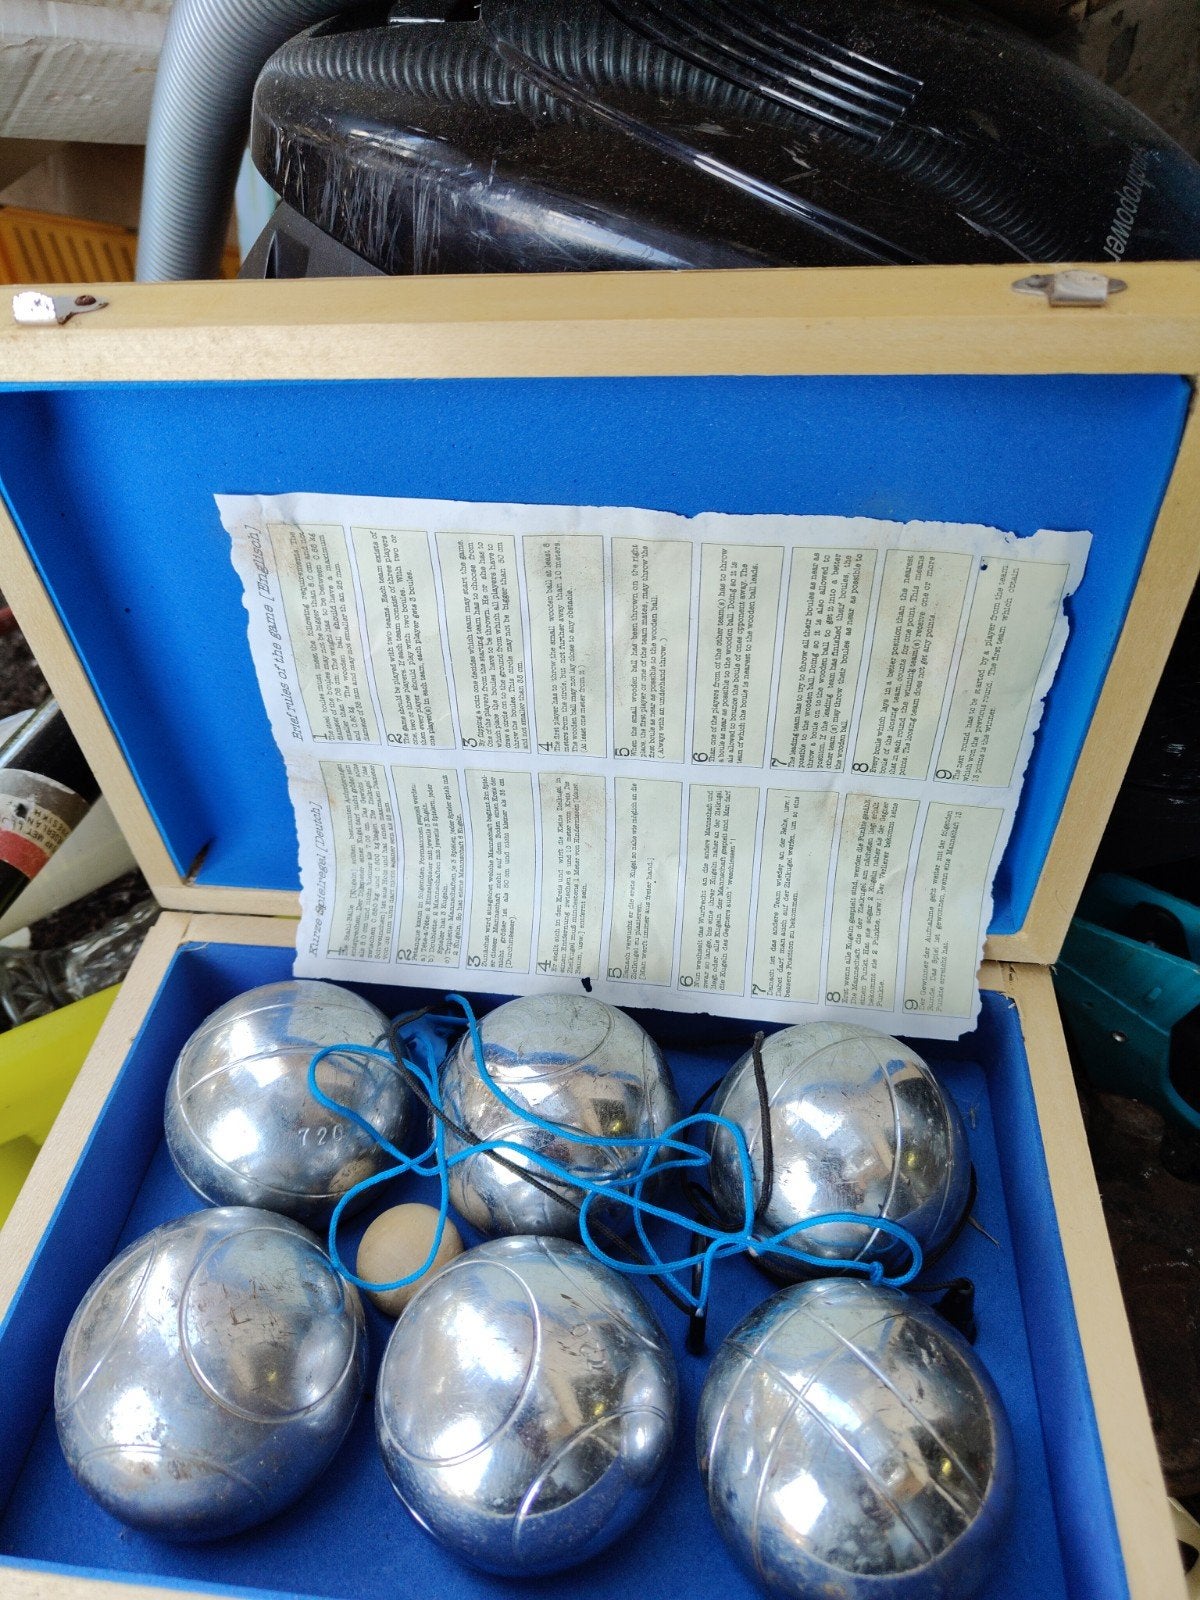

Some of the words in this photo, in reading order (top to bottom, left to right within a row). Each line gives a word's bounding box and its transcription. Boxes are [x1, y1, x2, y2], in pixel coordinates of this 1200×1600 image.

[244, 524, 274, 600] [Englisch]
[387, 733, 403, 742] 2
[462, 737, 477, 747] 3
[538, 740, 552, 751] 4
[615, 747, 629, 756] 5
[693, 751, 708, 762] 6
[771, 758, 787, 767] 7
[852, 762, 869, 772] 8
[935, 768, 953, 779] 9
[329, 945, 340, 955] 1
[397, 948, 411, 960] 2
[467, 954, 480, 967] 3
[537, 959, 550, 972] 4
[608, 967, 622, 978] 5
[679, 975, 693, 987] 6
[752, 983, 766, 995] 7
[826, 991, 841, 1002] 8
[903, 999, 918, 1009] 9
[297, 1122, 344, 1146] 720
